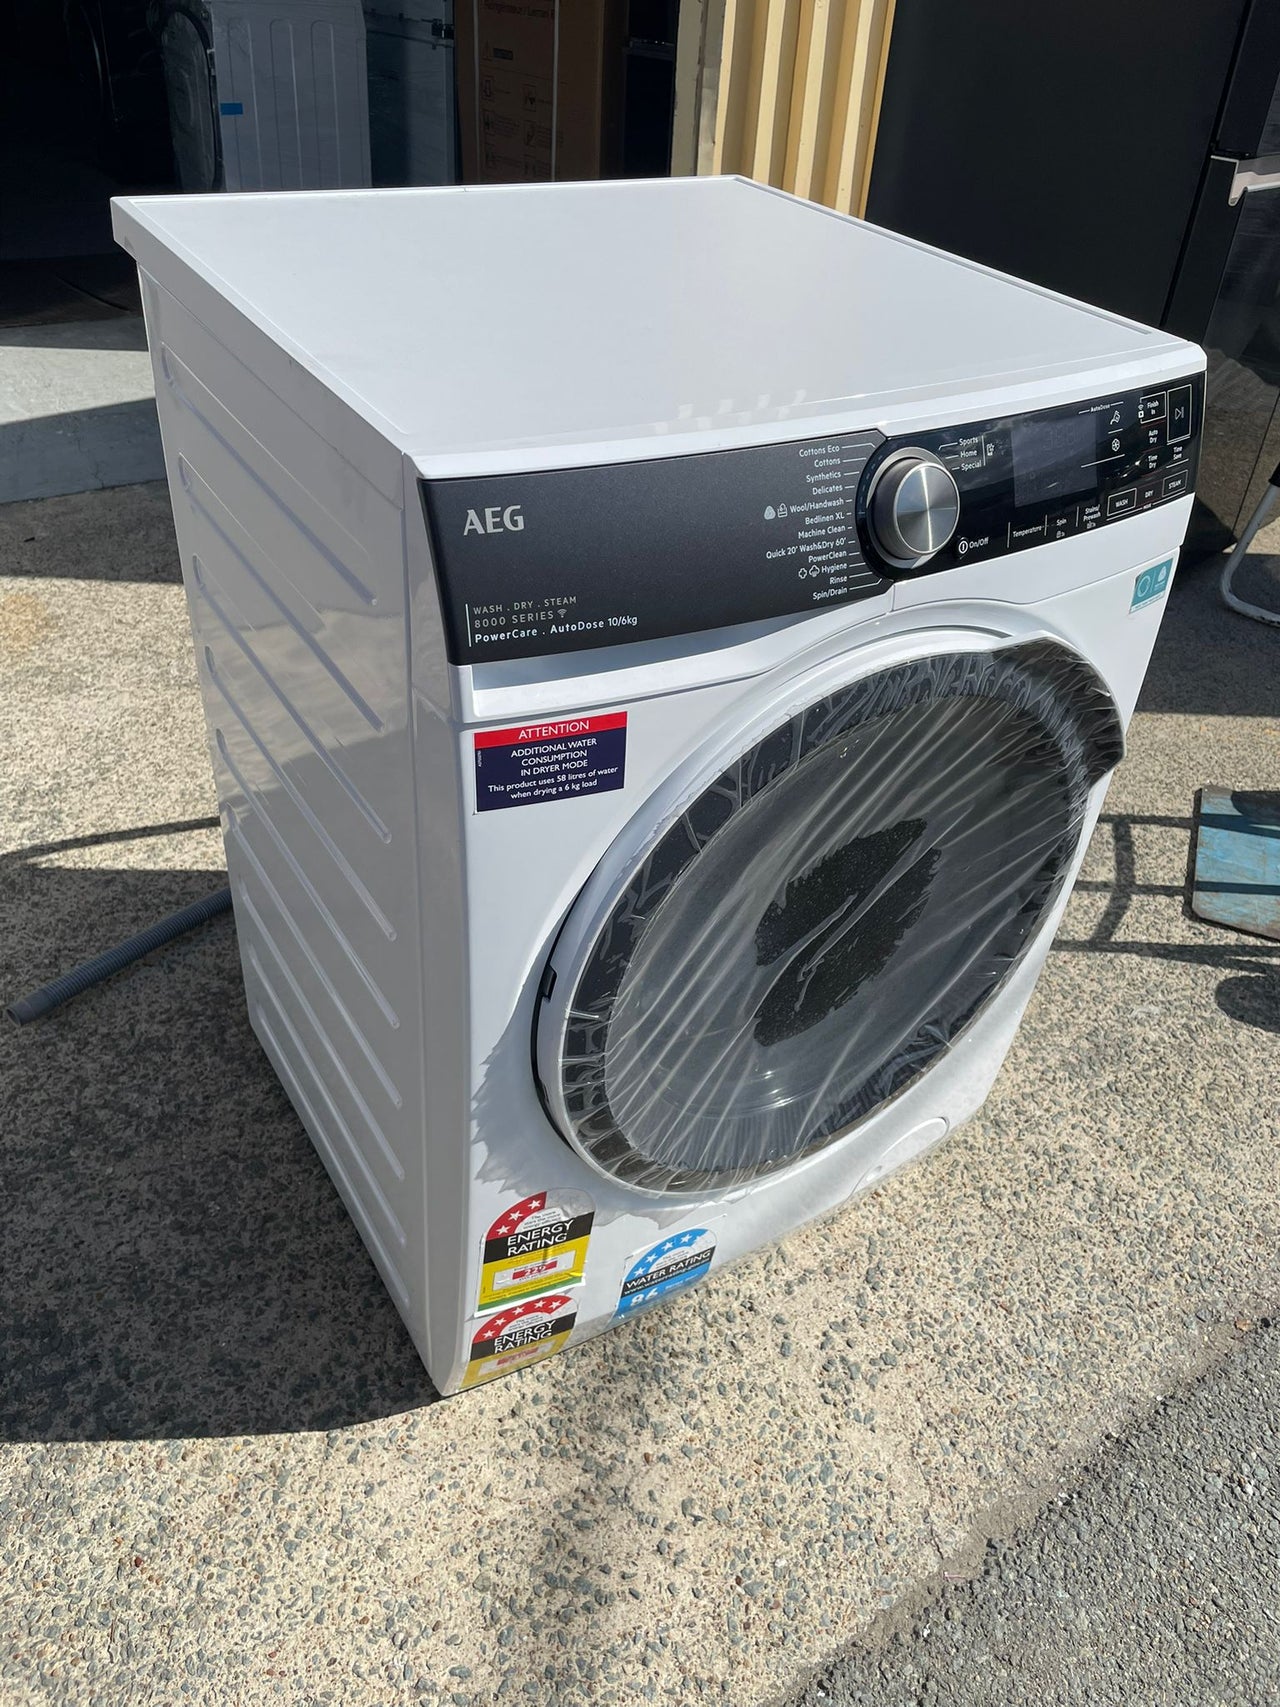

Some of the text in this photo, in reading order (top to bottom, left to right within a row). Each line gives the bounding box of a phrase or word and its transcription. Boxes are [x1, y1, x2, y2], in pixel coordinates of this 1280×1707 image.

[1090, 404, 1110, 413] AutoDose
[1148, 429, 1158, 437] Auto
[959, 437, 979, 446] Sports
[1149, 436, 1158, 444] Dry
[799, 445, 840, 457] Cottons Eco
[960, 449, 977, 458] Home
[814, 458, 841, 467] Cottons
[961, 460, 982, 471] Special
[806, 471, 841, 483] Synthetics
[812, 484, 843, 495] Delicates
[1145, 490, 1154, 498] DRY
[790, 498, 844, 513] Wool/Handwash
[1115, 499, 1129, 508] WASH
[463, 505, 525, 536] AEG
[805, 512, 844, 525] Bedlinen XL
[1056, 518, 1067, 526] Spin
[798, 525, 846, 539] Machine Clean
[1012, 525, 1042, 538] Temperature
[969, 536, 989, 549] On/Off
[766, 548, 786, 559] Quick
[799, 541, 834, 553] Wash&Dry
[808, 550, 847, 563] PowerClean
[821, 563, 847, 574] Hygiene
[829, 576, 847, 585] Rinse
[812, 587, 848, 601] Spin/Drain
[473, 596, 577, 615] WASH DRY STEAM
[474, 610, 554, 629] 8000 SERIES
[474, 615, 638, 644] PowerCare AutoDose 10/6kg
[518, 720, 589, 740] ATTENTION
[511, 738, 597, 758] ADDITIONAL WATER
[521, 750, 587, 767] CONSUMPTION
[521, 759, 588, 776] IN DRYER MODE
[488, 766, 618, 793] This product uses 58 litres of water
[510, 790, 531, 799] when
[533, 785, 557, 797] drying
[571, 781, 580, 791] kg
[582, 779, 598, 788] load
[507, 1219, 574, 1246] ENERGY
[507, 1233, 567, 1257] RATING
[626, 1269, 666, 1289] WATER
[669, 1250, 711, 1273] RATING
[494, 1320, 556, 1346] ENERGY
[494, 1329, 552, 1354] RATING
